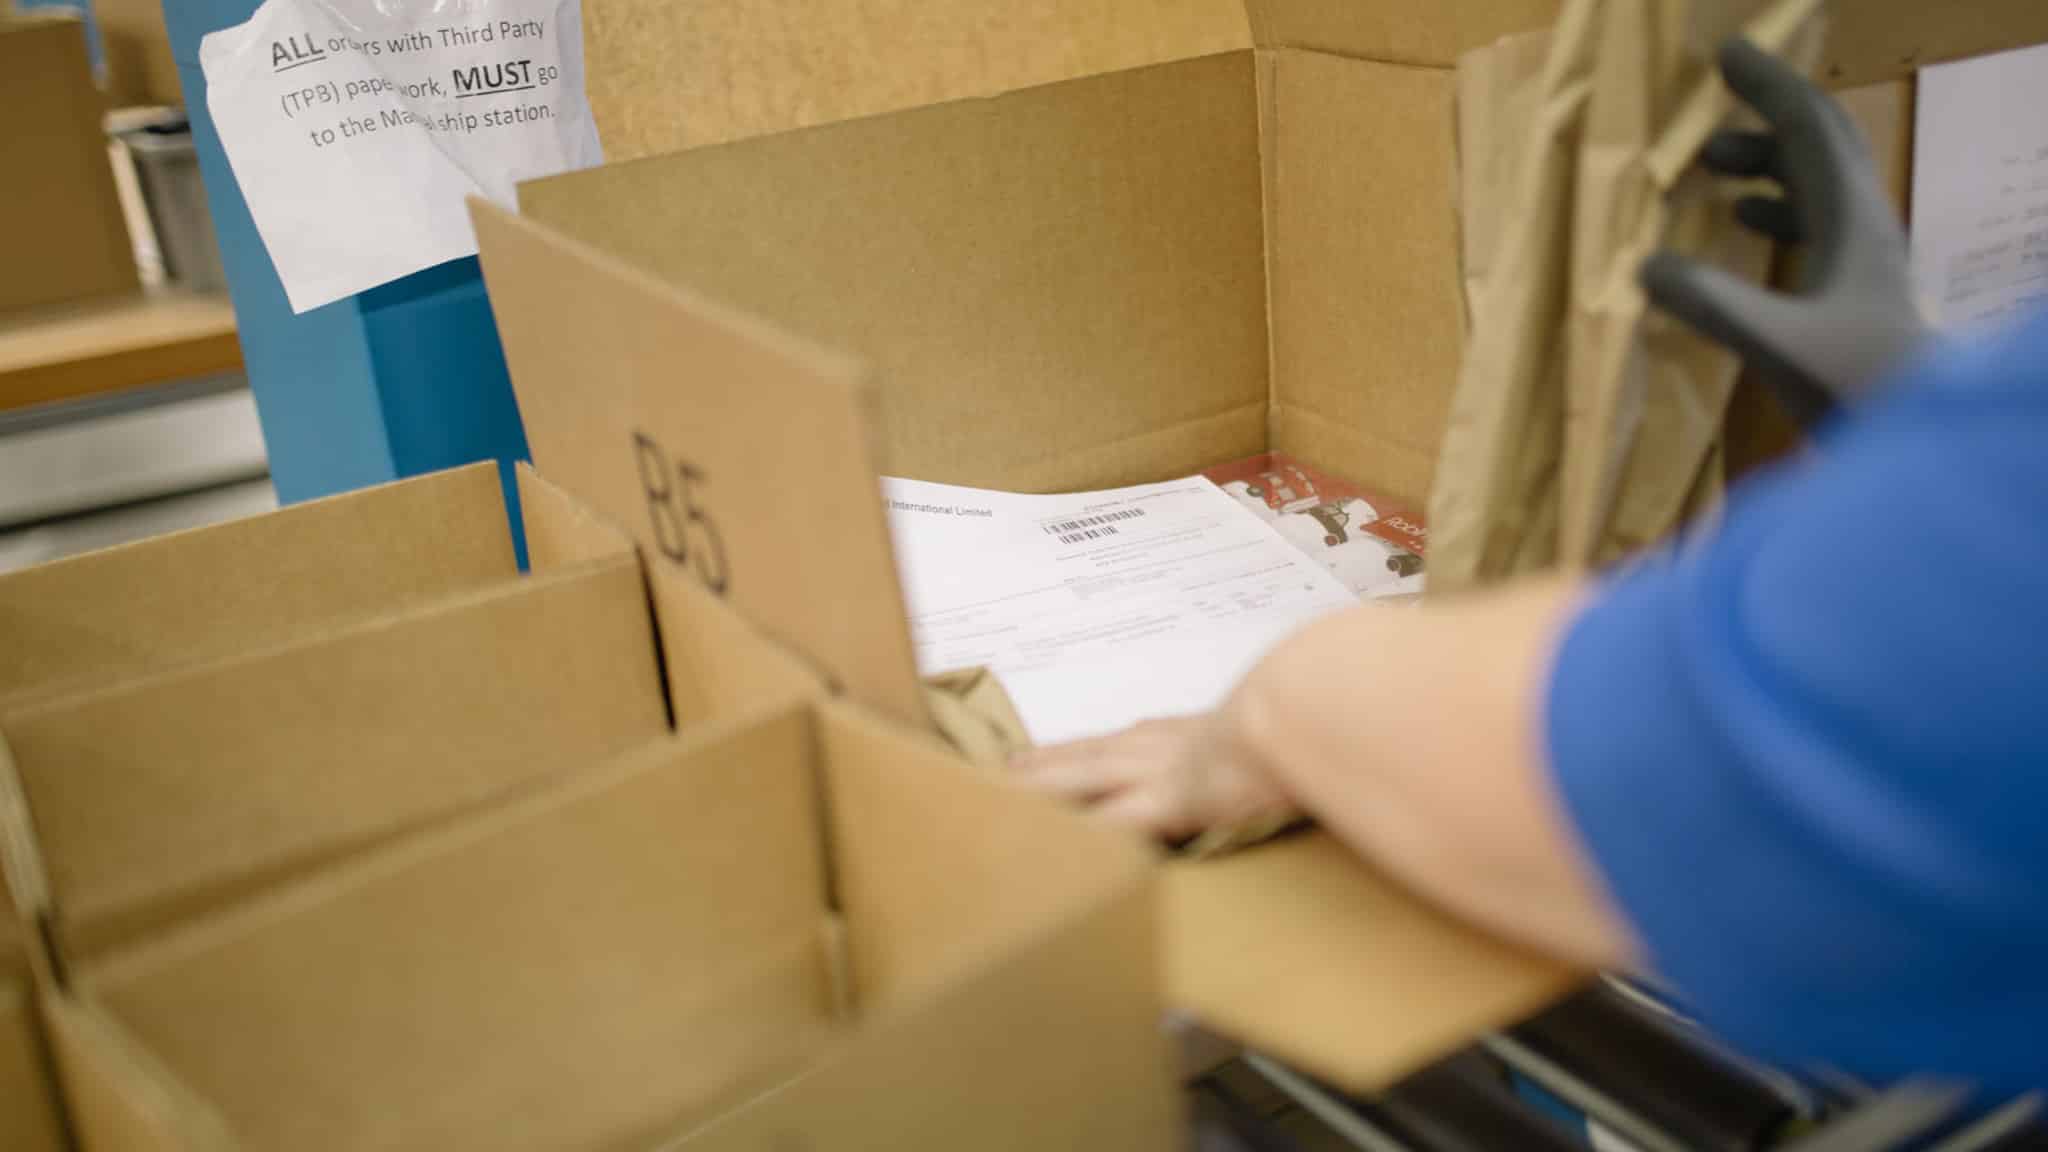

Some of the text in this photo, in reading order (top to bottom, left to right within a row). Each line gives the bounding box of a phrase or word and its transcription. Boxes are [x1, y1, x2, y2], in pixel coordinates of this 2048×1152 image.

[272, 33, 325, 68] ALL
[386, 31, 432, 53] with
[437, 22, 493, 47] Third
[499, 20, 544, 40] Party
[281, 80, 340, 119] (TPB)
[452, 59, 533, 95] MUST
[537, 65, 558, 86] go
[311, 131, 335, 147] to
[339, 116, 376, 138] the
[437, 112, 477, 134] ship
[483, 103, 556, 128] station.
[630, 430, 729, 598] B5
[891, 500, 953, 515] International
[955, 504, 993, 518] Limited
